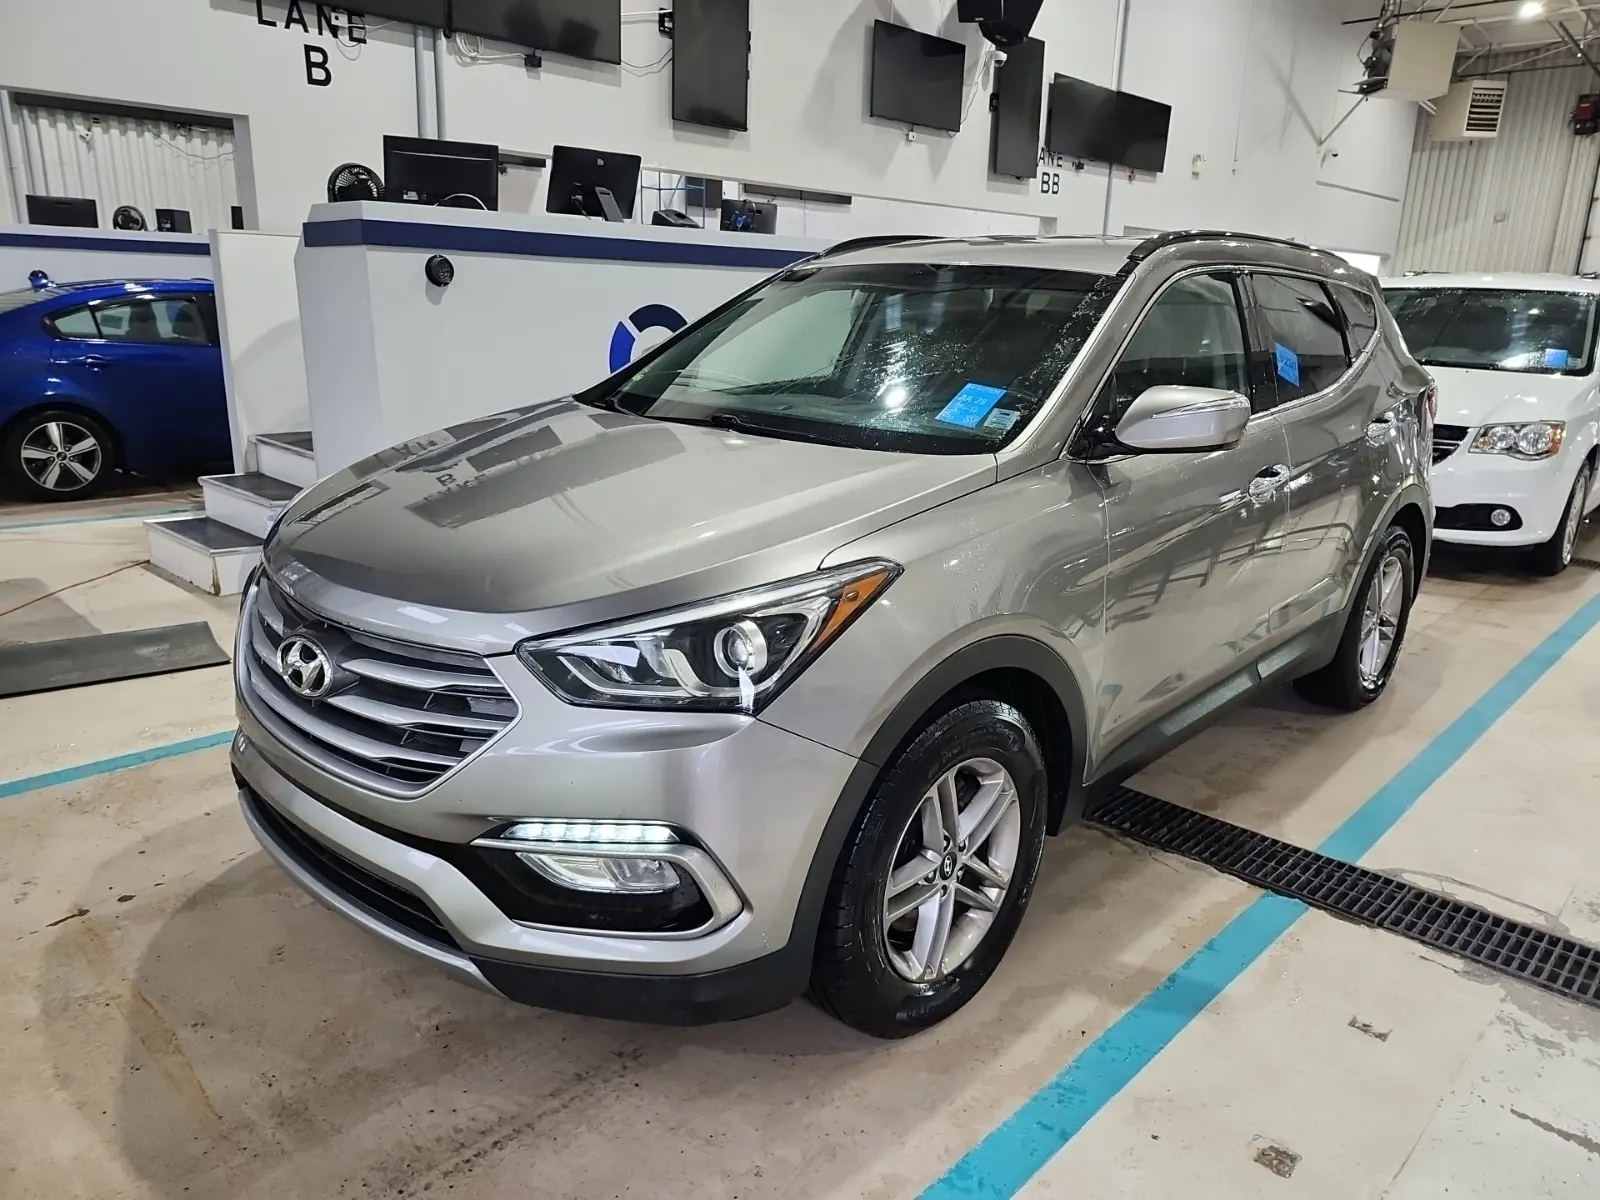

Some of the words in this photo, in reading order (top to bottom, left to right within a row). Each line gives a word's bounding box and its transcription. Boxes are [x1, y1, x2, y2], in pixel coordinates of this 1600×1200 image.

[256, 0, 367, 44] LANE
[303, 44, 332, 87] B
[1038, 146, 1063, 168] ANE
[1041, 171, 1060, 195] BB
